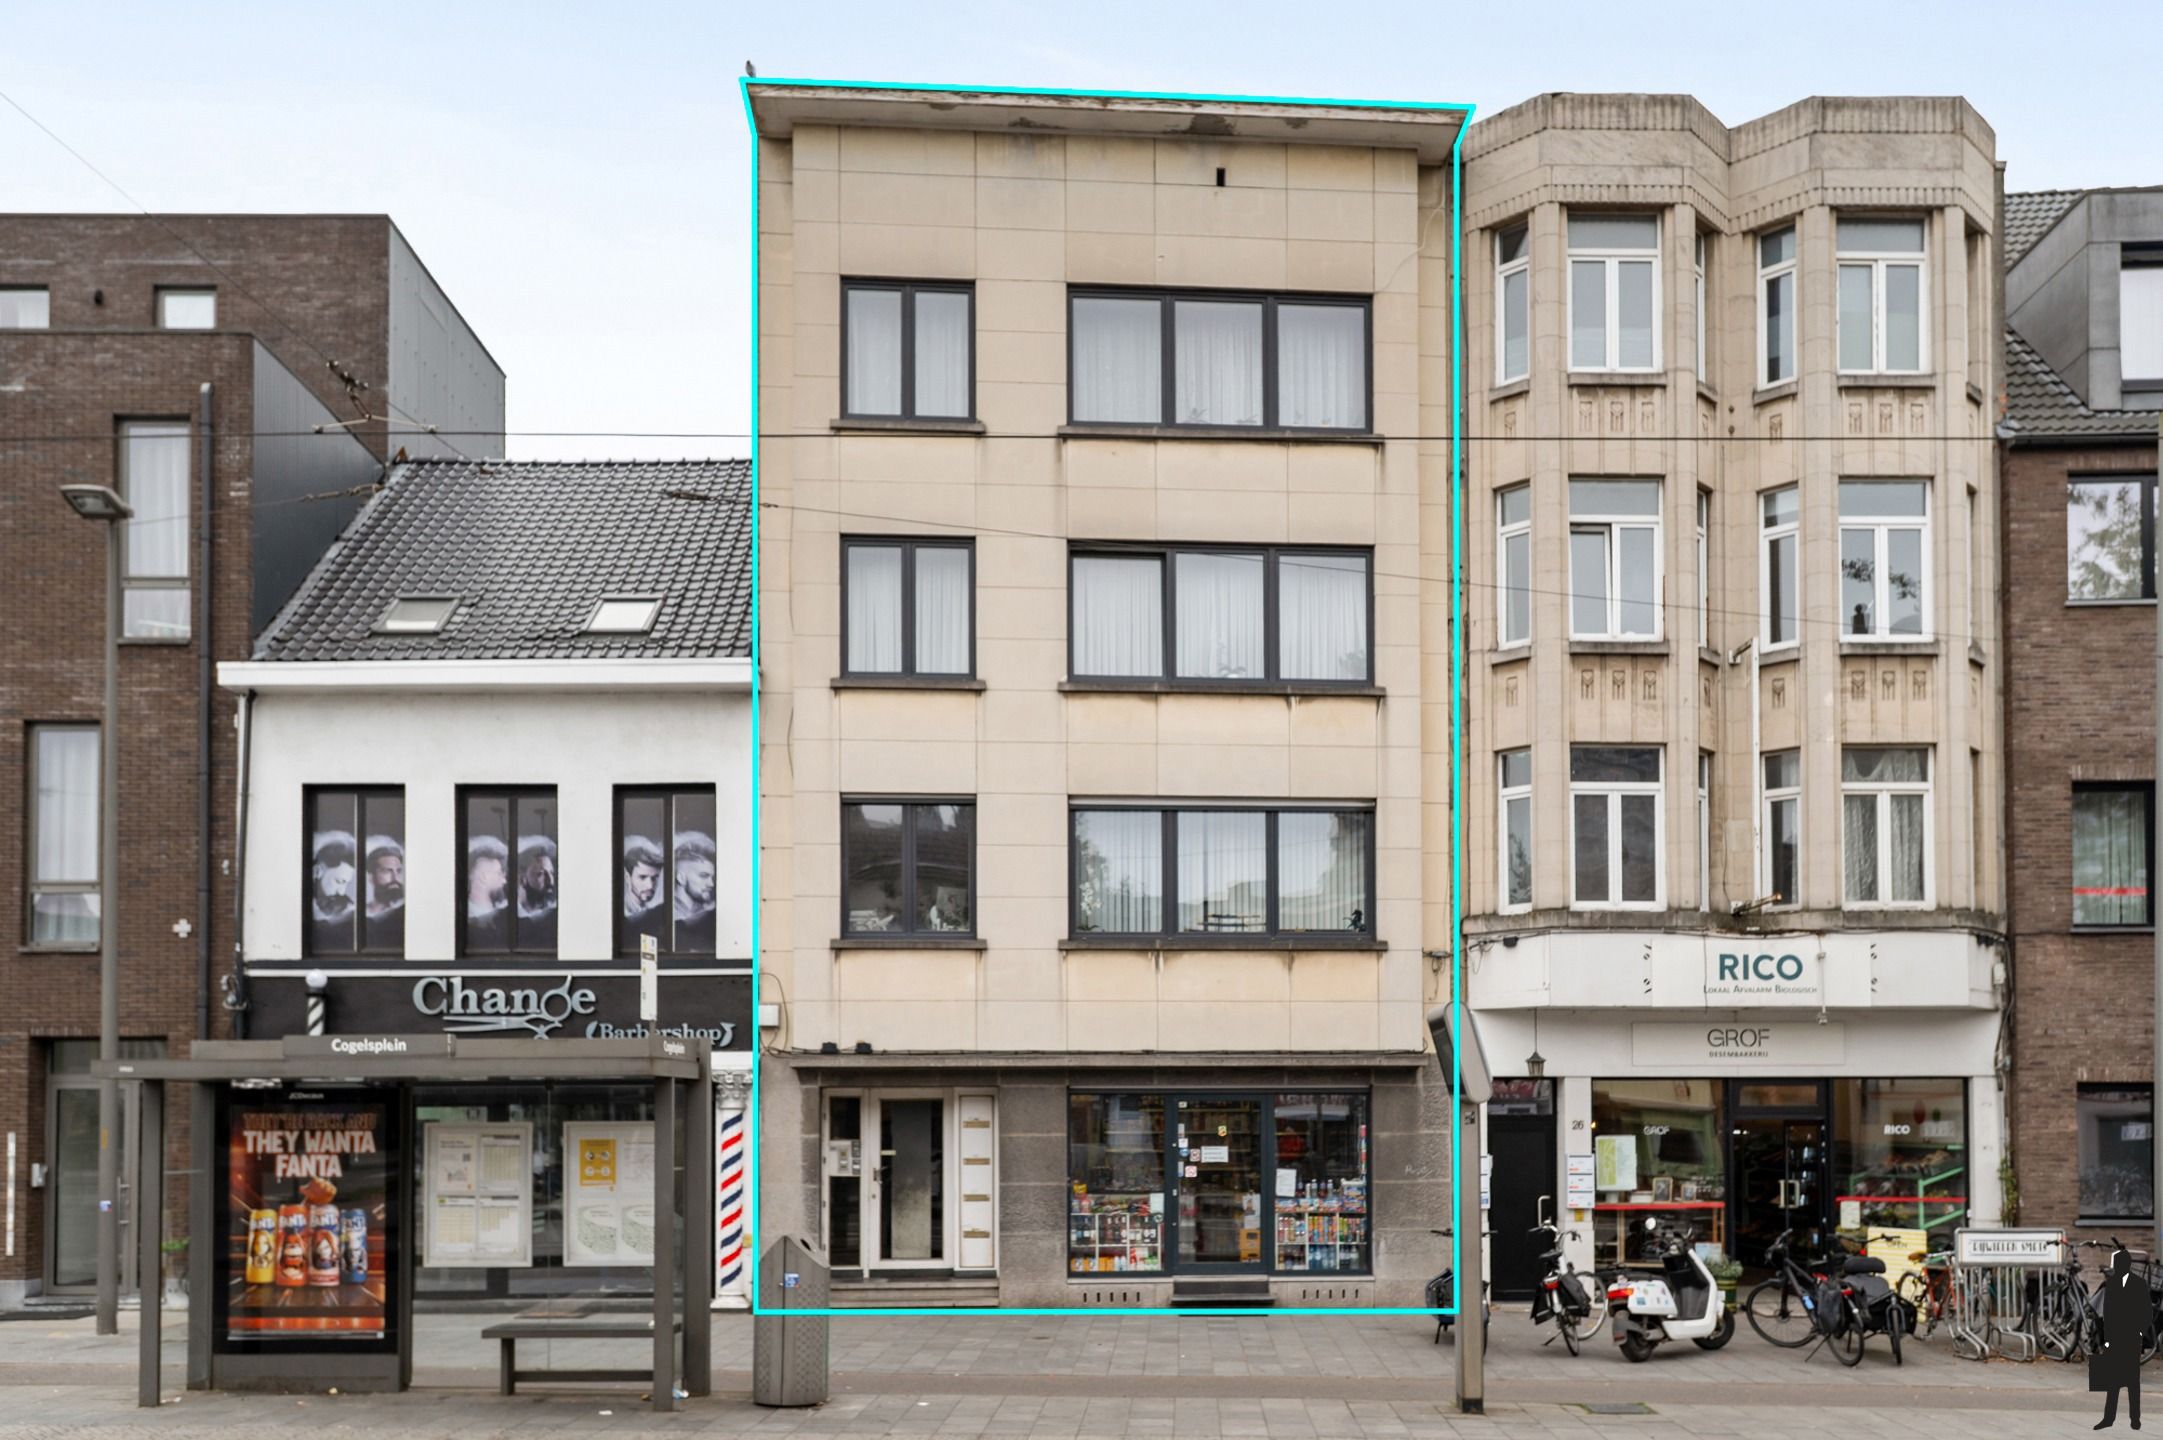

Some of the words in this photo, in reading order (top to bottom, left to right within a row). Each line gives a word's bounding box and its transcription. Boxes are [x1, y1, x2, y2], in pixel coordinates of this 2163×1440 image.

[1718, 953, 1804, 981] RICO
[331, 1037, 407, 1055] Cogelsplein
[1707, 1028, 1771, 1048] GROF
[1571, 1120, 1585, 1130] 26
[1883, 1124, 1911, 1135] RICO
[243, 1130, 300, 1154] THEY
[304, 1130, 377, 1154] WANTA
[275, 1154, 343, 1178] FANTA
